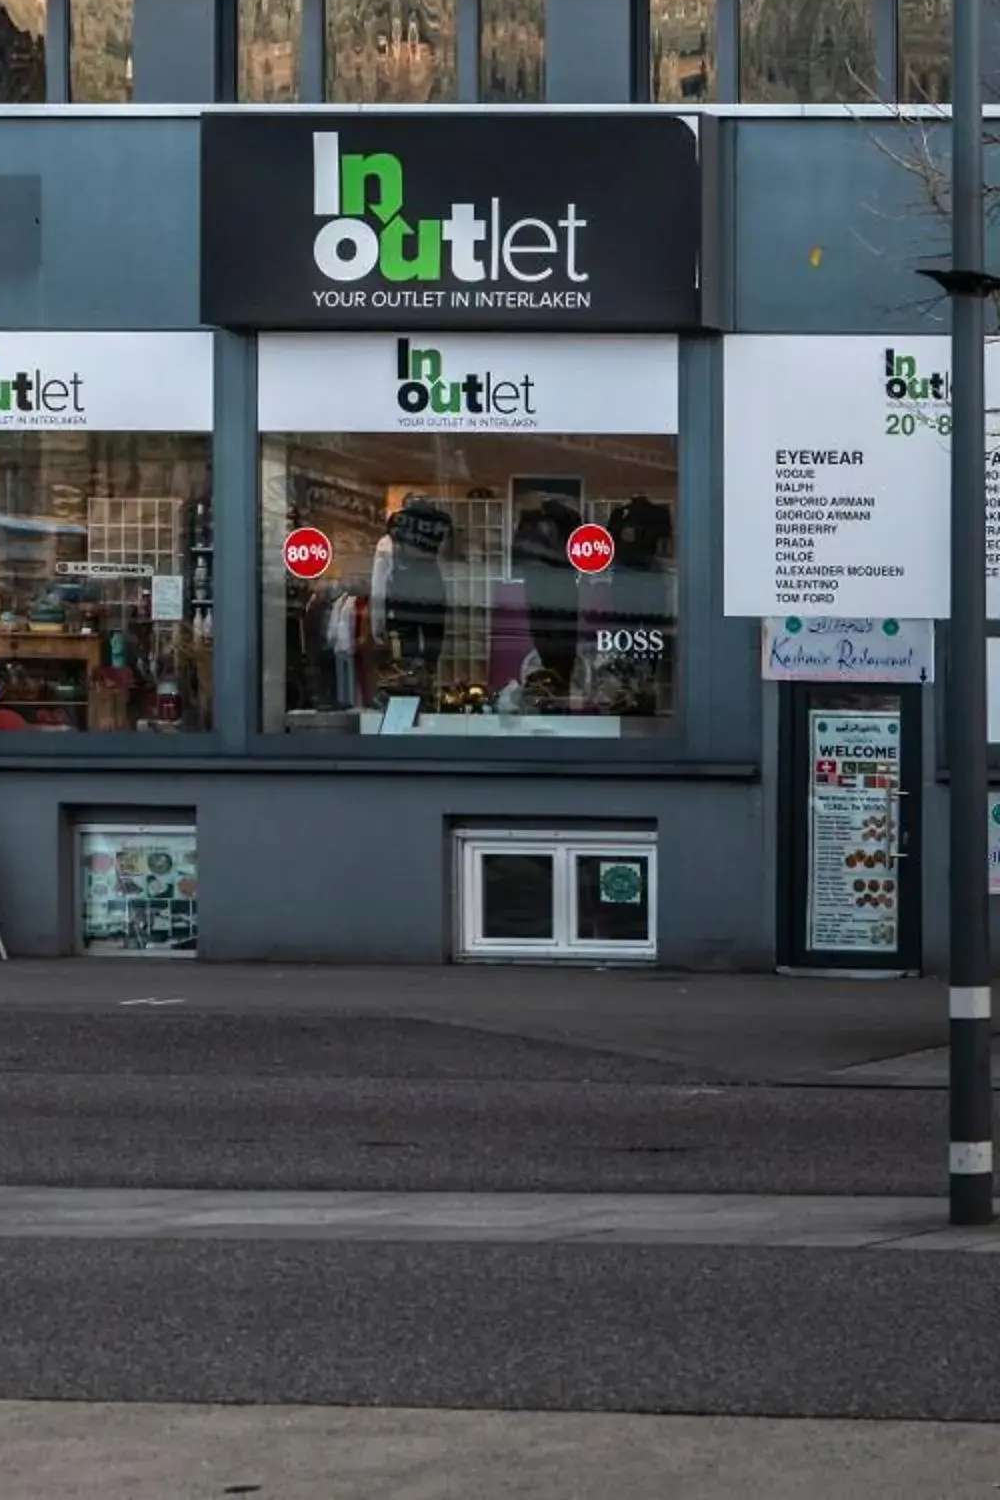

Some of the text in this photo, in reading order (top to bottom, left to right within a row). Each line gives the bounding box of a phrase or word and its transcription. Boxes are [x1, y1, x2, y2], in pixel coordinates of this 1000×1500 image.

[312, 131, 403, 224] In
[313, 197, 589, 282] outlet
[312, 290, 591, 308] YOUR OUTLET IN INTERLAKEN
[397, 338, 441, 385] In
[885, 348, 916, 379] In
[886, 371, 952, 399] outl
[397, 372, 536, 414] outlet
[775, 450, 864, 465] EYEWEAR
[775, 469, 815, 479] VOGUE
[775, 482, 814, 492] RALPH
[775, 496, 875, 507] EMPORIO ARMANI
[775, 510, 870, 520] GIORGIO ARMANI
[775, 524, 838, 534] BURBERRY
[571, 540, 611, 557] 40%
[775, 538, 815, 548] PRADA
[287, 544, 327, 562] 80%
[775, 552, 815, 562] CHLOE
[775, 566, 905, 576] ALEXANDER MCQUEEN
[775, 580, 839, 590] VALENTINO
[776, 593, 835, 603] TOM FORD
[596, 629, 664, 652] BOSS
[820, 744, 897, 758] WELCOME
